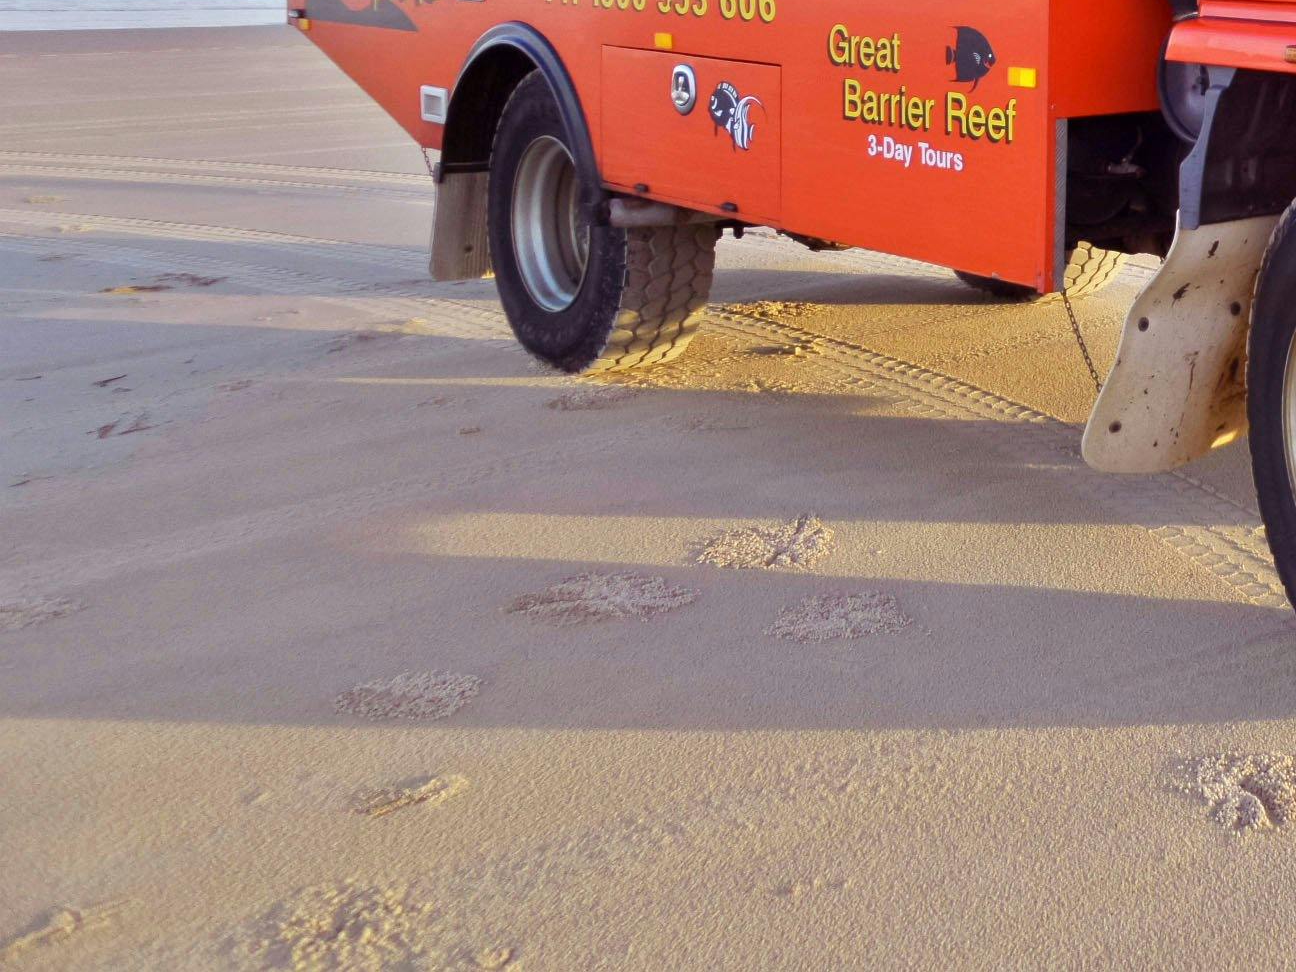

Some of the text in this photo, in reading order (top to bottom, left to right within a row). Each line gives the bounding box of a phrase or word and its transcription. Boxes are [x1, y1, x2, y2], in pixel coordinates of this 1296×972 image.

[828, 24, 901, 70] Great
[844, 78, 1017, 142] Barrier Reef
[868, 135, 963, 172] 3-Day Tours
